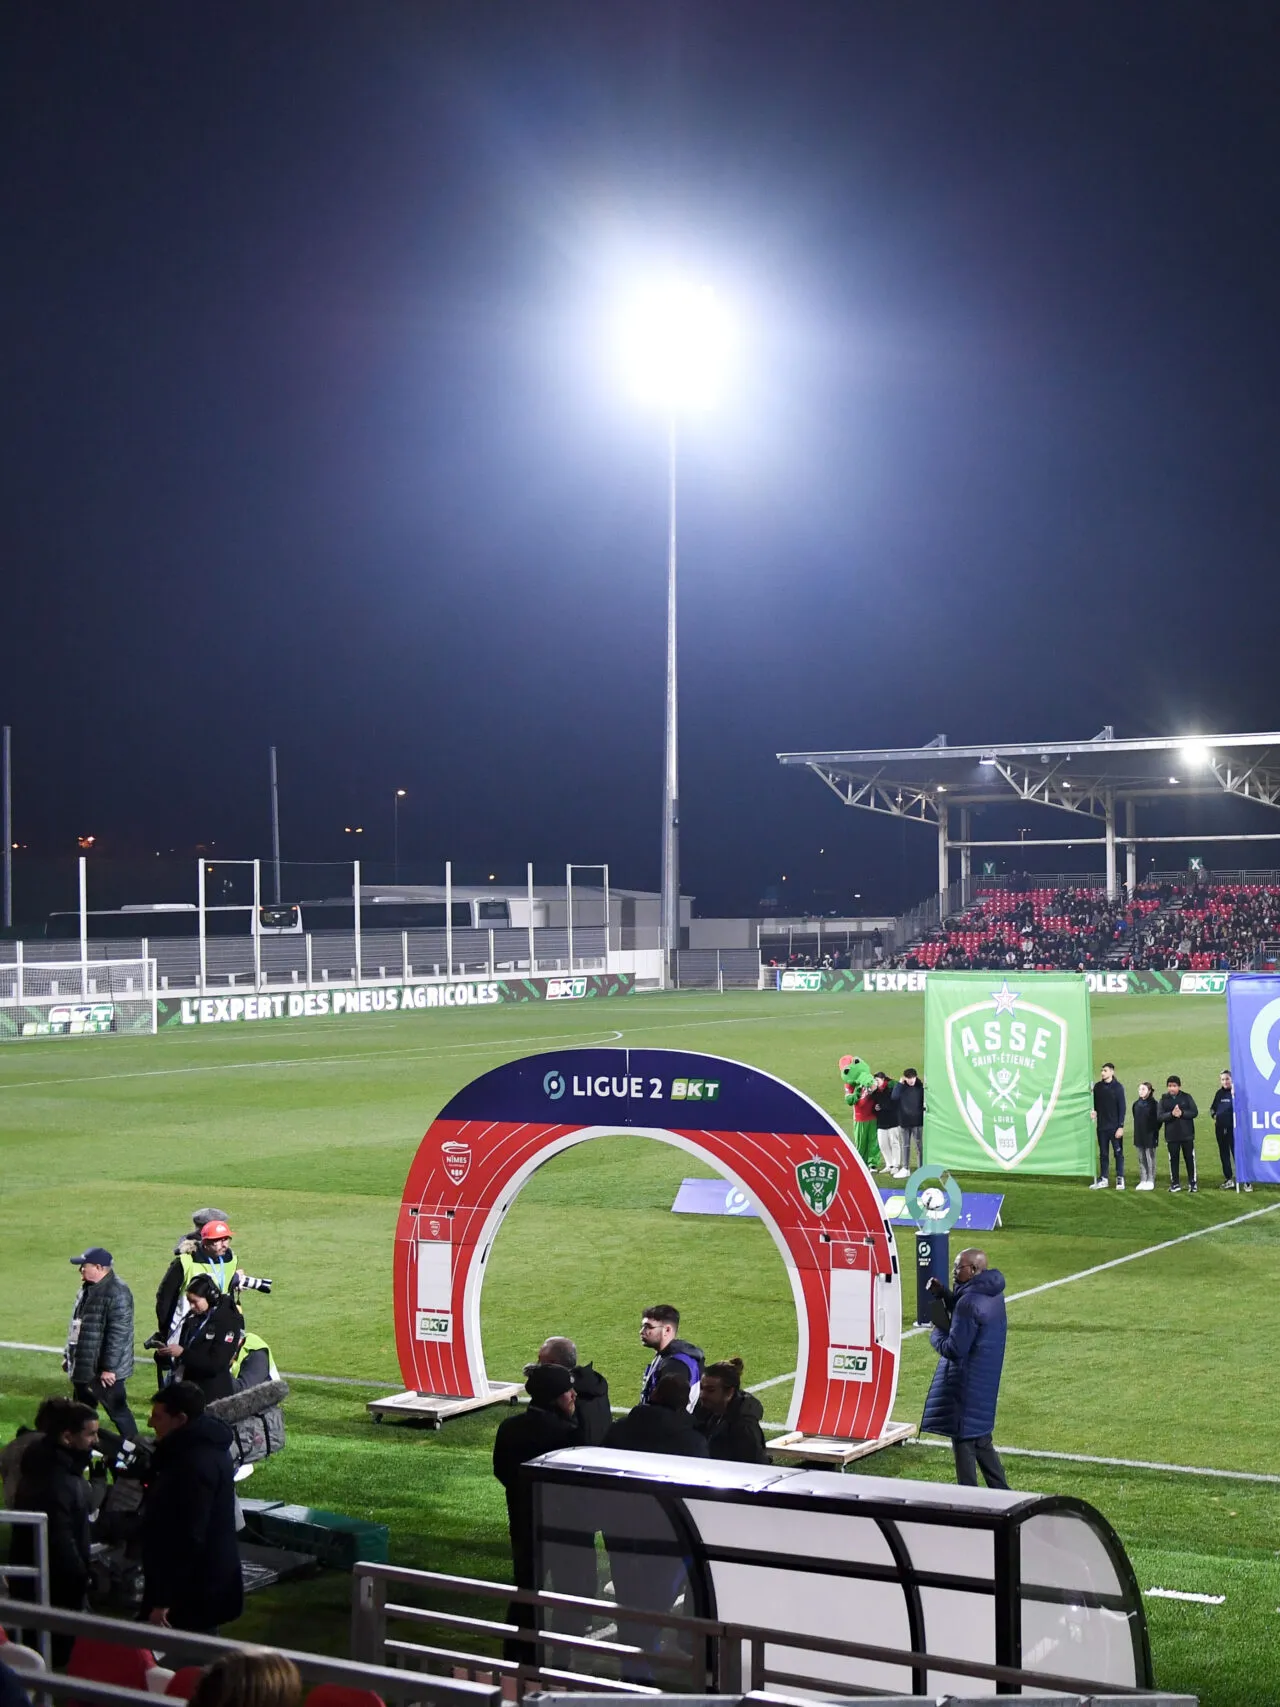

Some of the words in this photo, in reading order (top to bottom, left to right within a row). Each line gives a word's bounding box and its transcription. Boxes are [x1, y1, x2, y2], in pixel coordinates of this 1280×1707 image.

[983, 862, 995, 874] Y
[1191, 858, 1201, 870] X
[547, 978, 586, 999] BKT
[782, 972, 820, 990] BKT
[864, 973, 926, 991] L'EXPER
[1181, 974, 1226, 992] BKT
[181, 996, 286, 1024] L'EXPERT
[289, 993, 329, 1017] DES
[333, 988, 398, 1013] PNEUS
[400, 983, 499, 1010] AGRICOLES
[961, 1021, 1051, 1059] ASSE
[971, 1052, 1036, 1069] SAINT-ÉTIENNE
[573, 1076, 643, 1098] LIGUE
[650, 1078, 663, 1099] 2
[671, 1080, 719, 1099] BKT
[801, 1166, 835, 1180] ASSE
[420, 1317, 449, 1333] BKT
[833, 1354, 868, 1371] BKT
